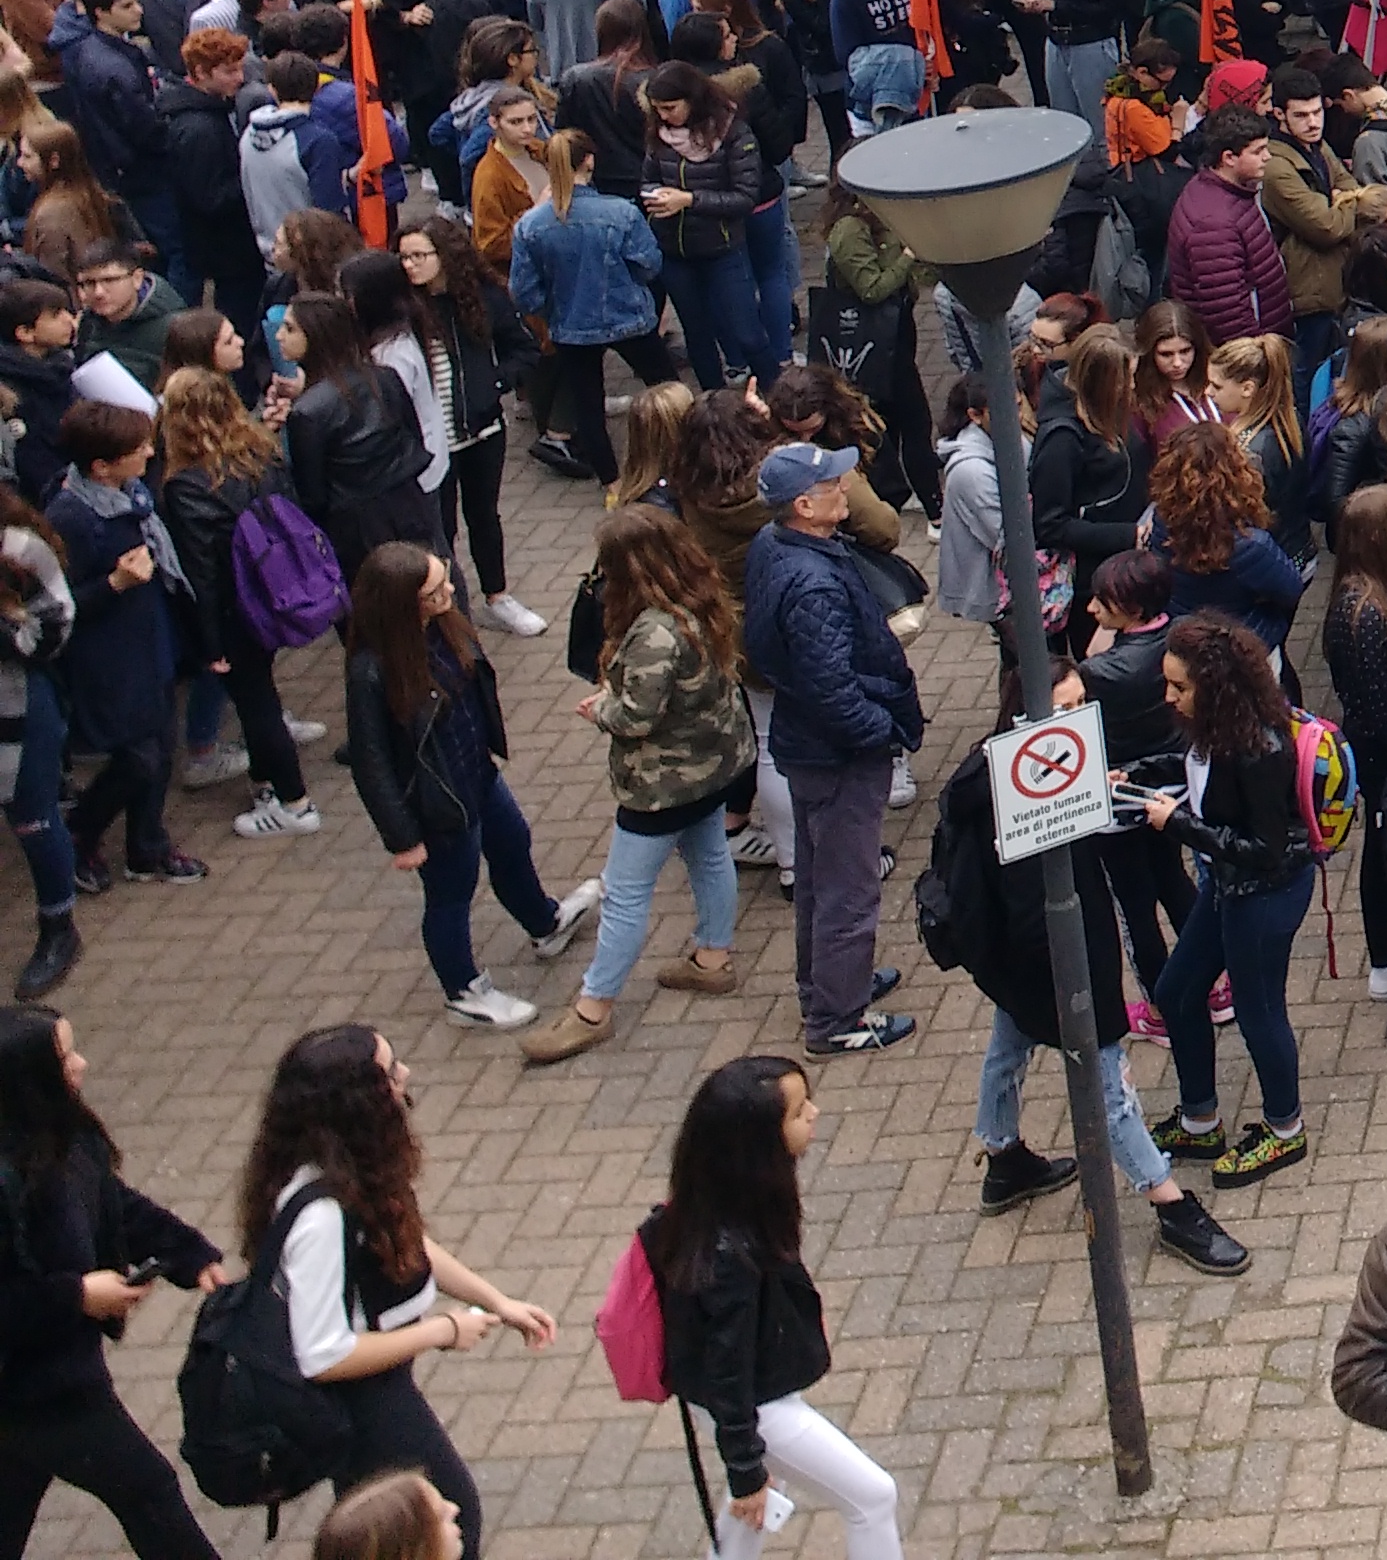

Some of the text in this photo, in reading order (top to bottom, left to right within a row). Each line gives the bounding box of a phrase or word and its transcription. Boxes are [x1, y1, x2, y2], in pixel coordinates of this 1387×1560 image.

[1005, 800, 1103, 841] area di pertinenza
[1012, 790, 1092, 825] Vietato fumare
[1035, 823, 1076, 845] esterna
